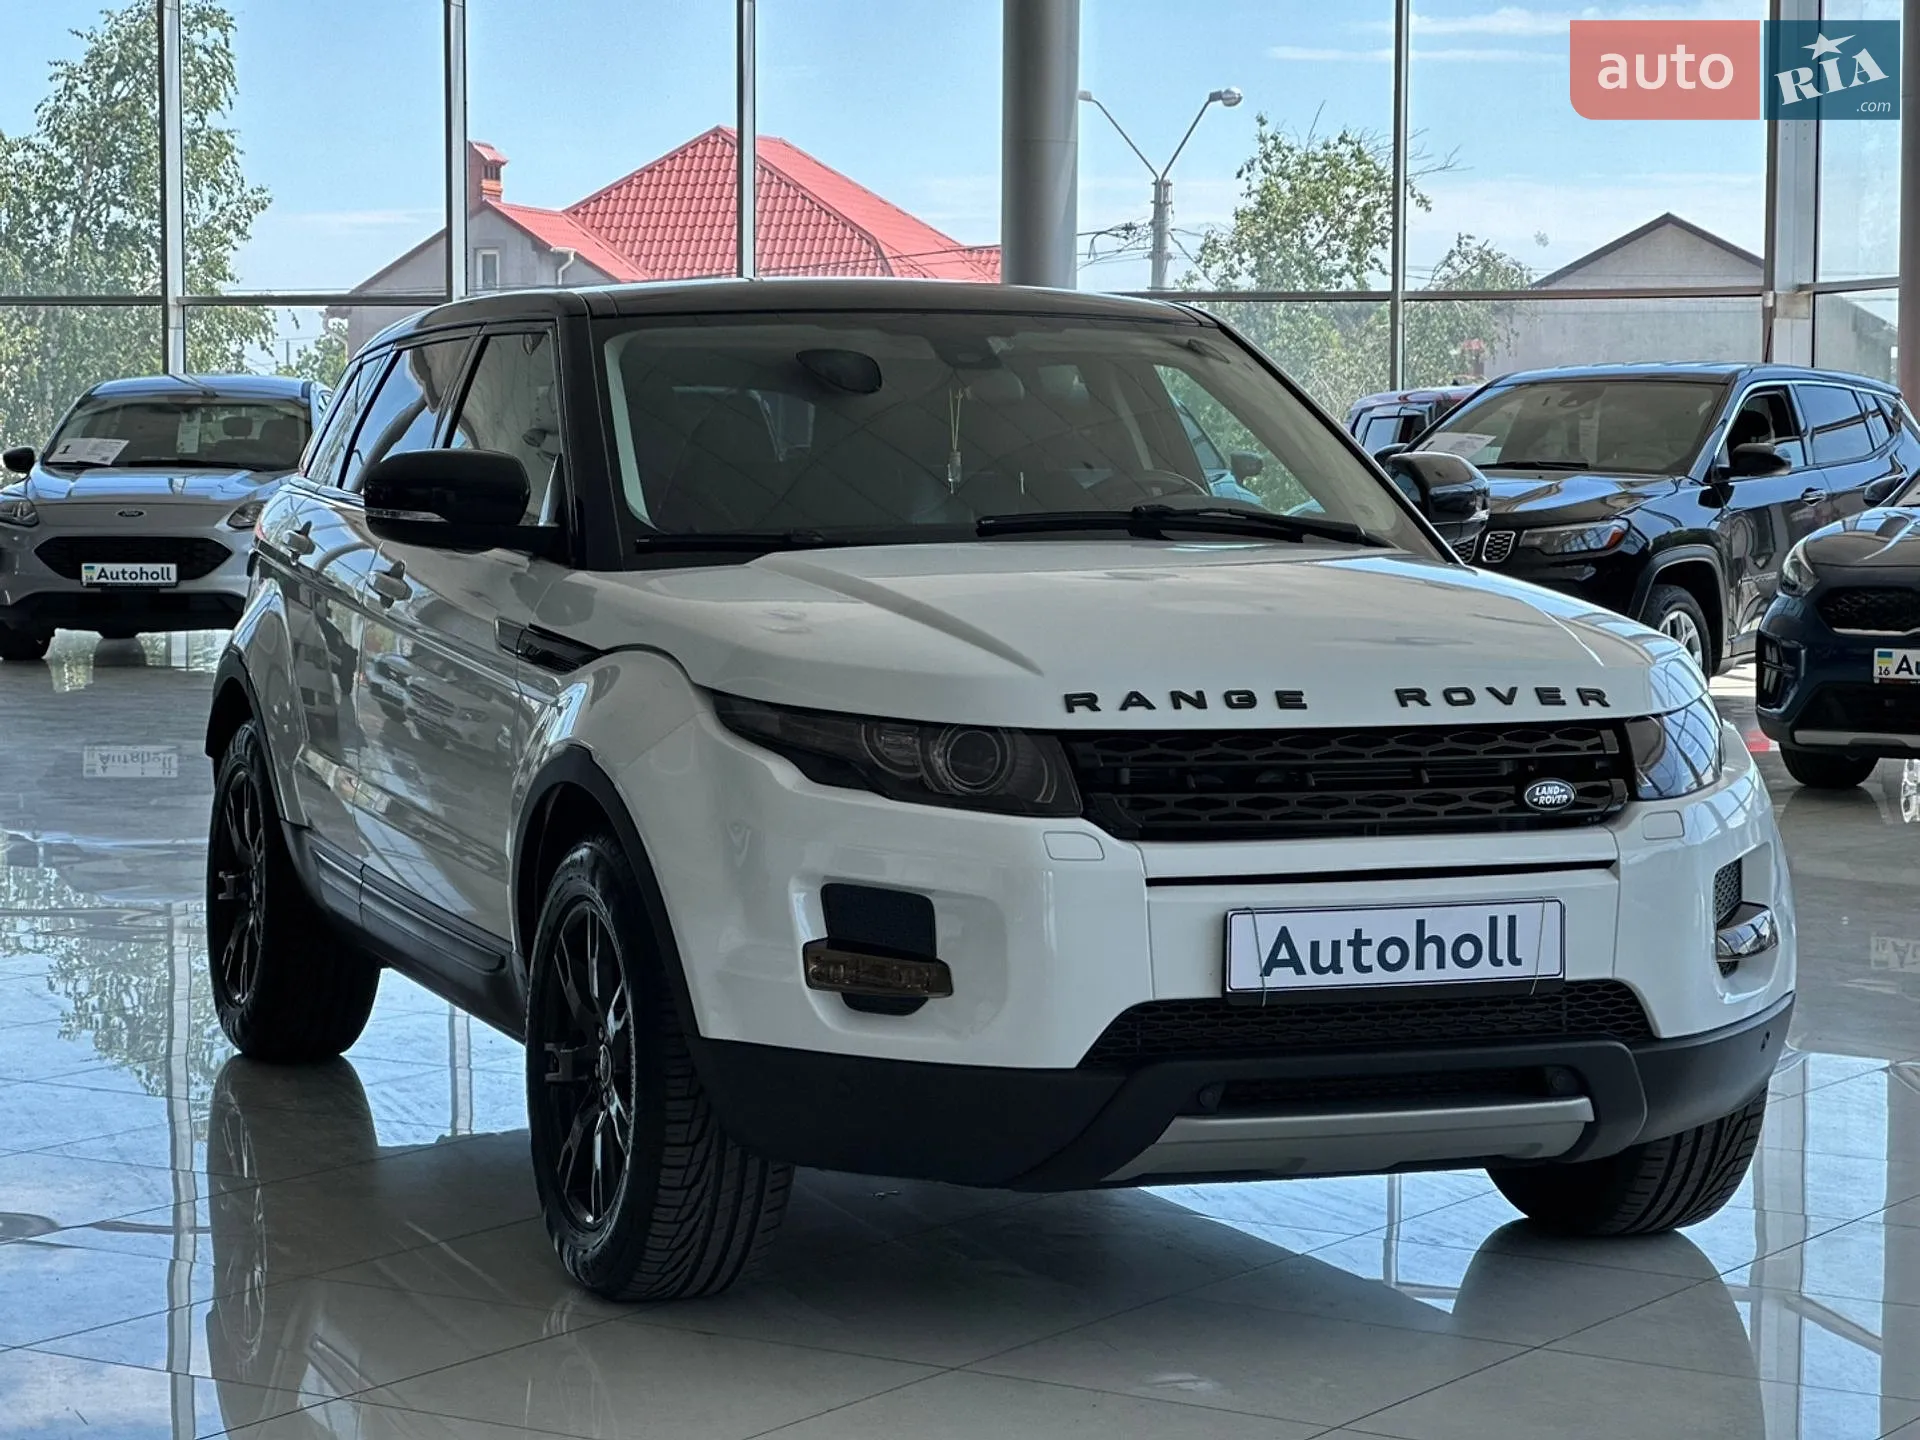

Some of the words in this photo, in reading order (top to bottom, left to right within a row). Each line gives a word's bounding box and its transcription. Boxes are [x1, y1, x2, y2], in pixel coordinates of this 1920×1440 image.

[97, 566, 172, 581] Autoholl
[1064, 689, 1308, 713] RANGE
[1394, 686, 1611, 707] ROVER
[1259, 914, 1523, 978] Autoholl
